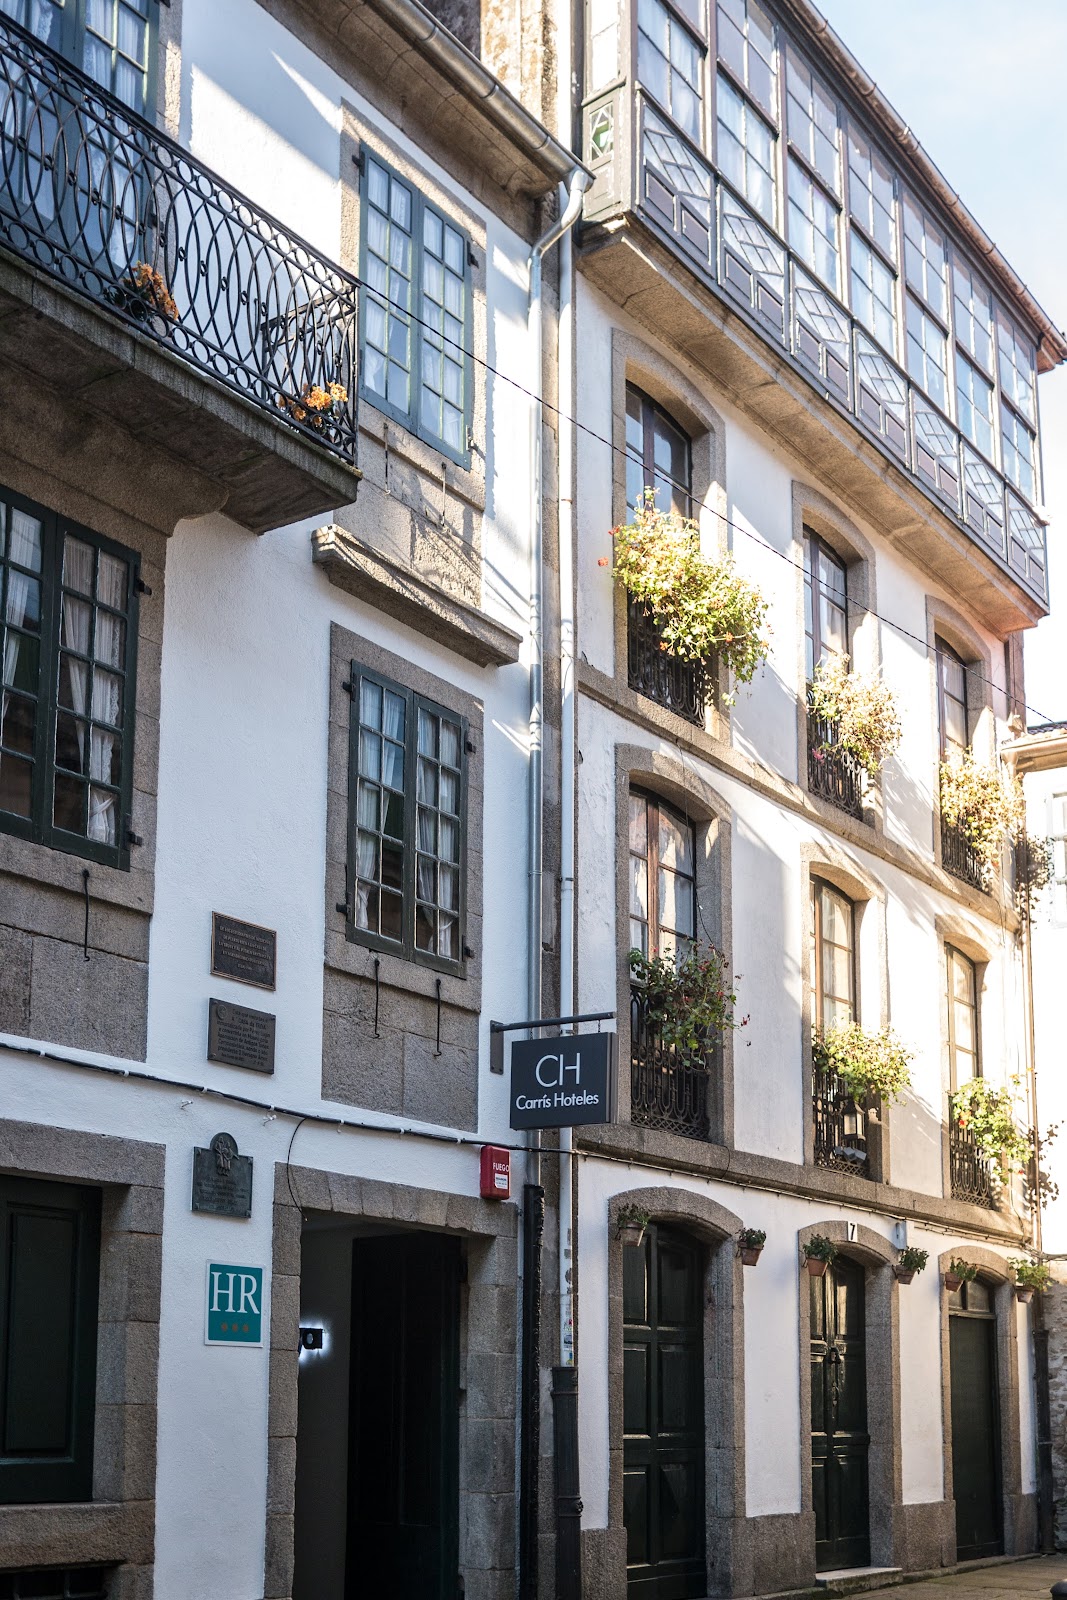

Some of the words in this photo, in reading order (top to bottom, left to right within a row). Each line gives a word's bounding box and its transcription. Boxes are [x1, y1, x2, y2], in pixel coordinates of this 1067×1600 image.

[535, 1052, 581, 1088] CH
[515, 1093, 552, 1110] Carrís
[553, 1090, 600, 1107] Hoteles
[493, 1162, 510, 1172] FUEGO
[850, 1223, 855, 1240] 7
[210, 1271, 260, 1314] HR
